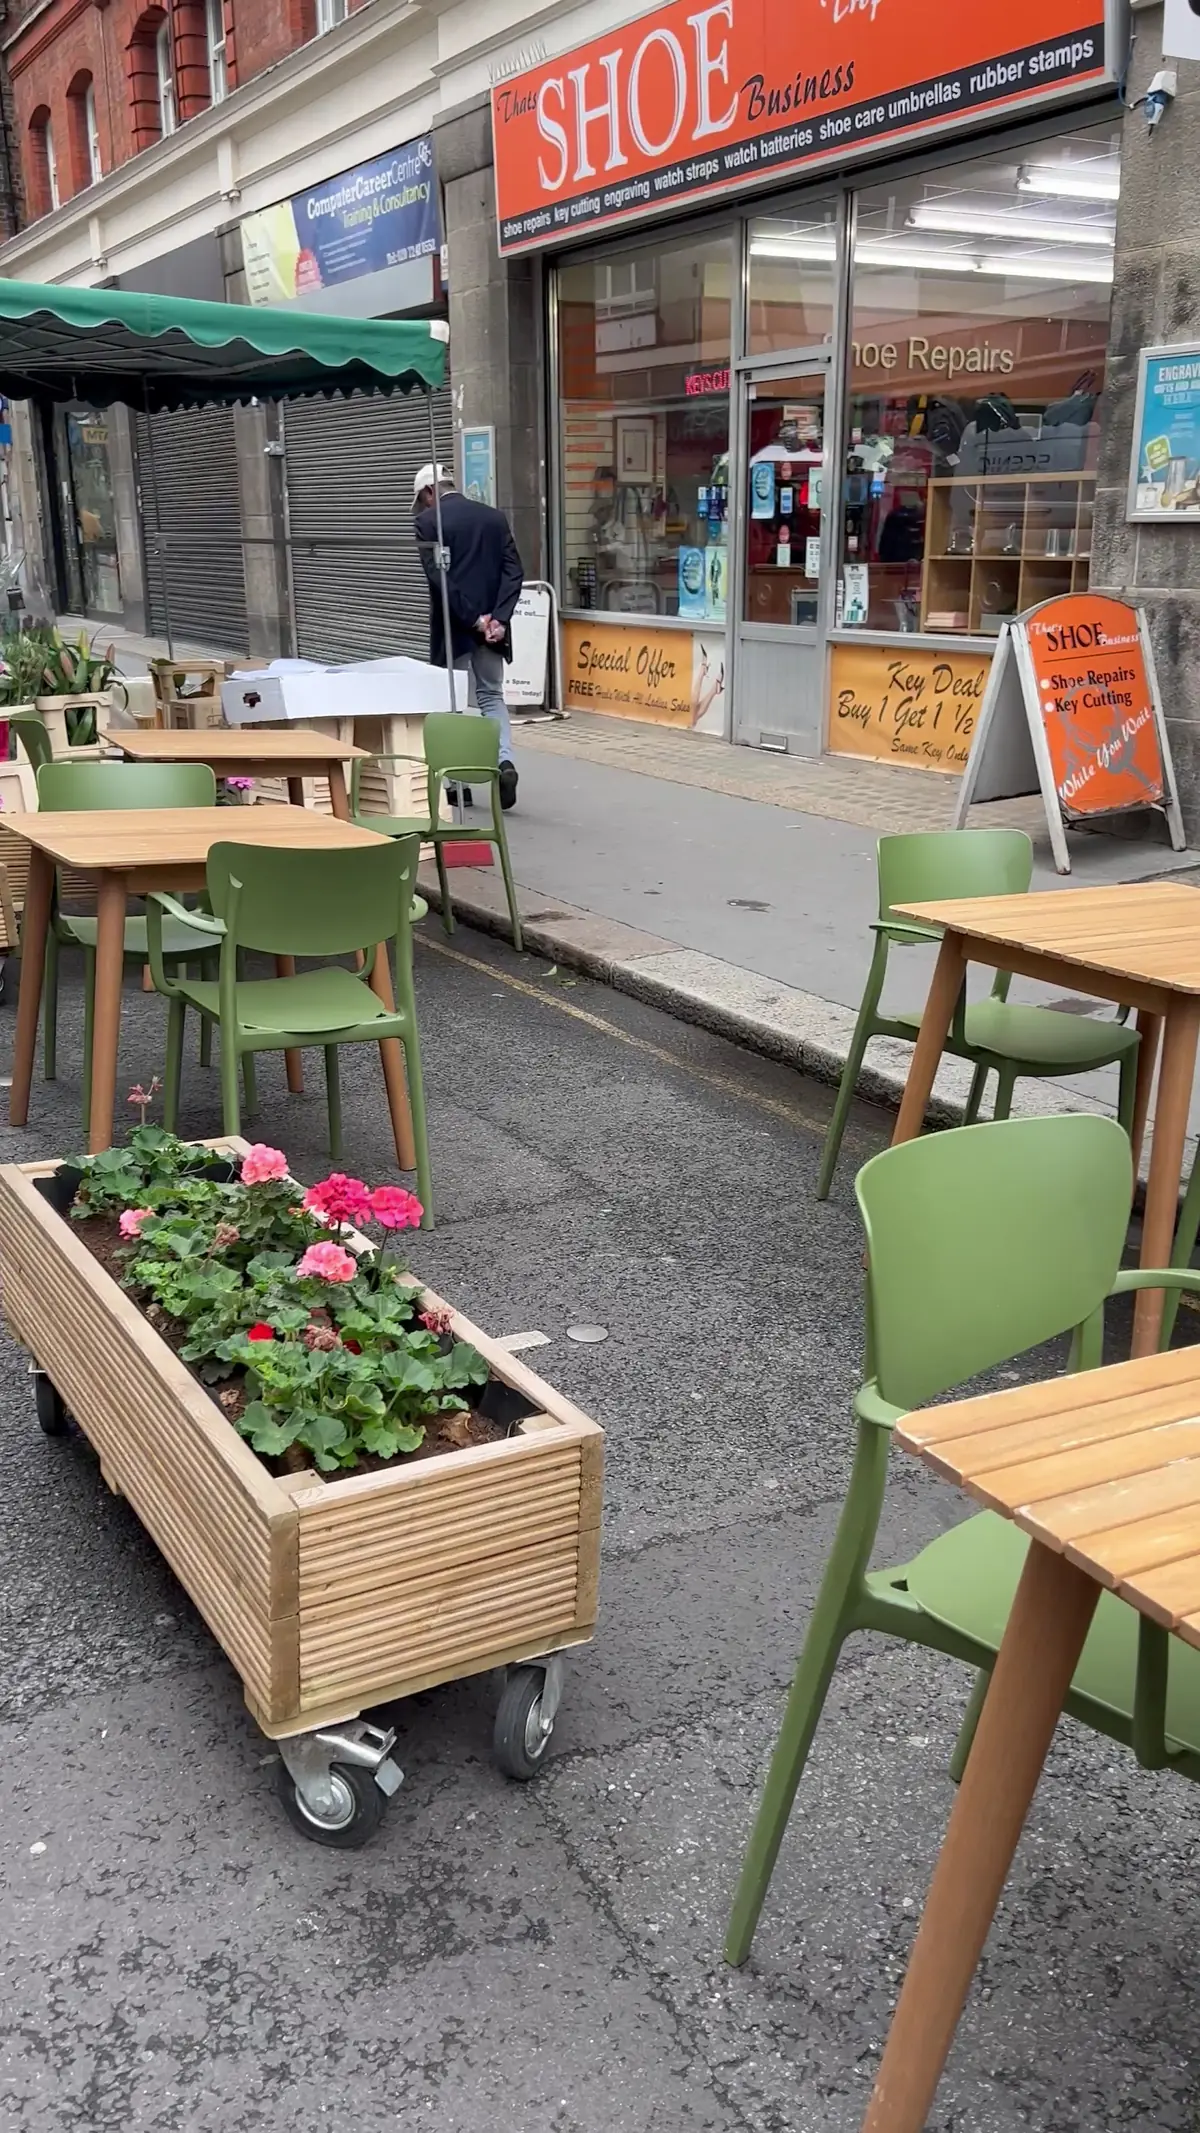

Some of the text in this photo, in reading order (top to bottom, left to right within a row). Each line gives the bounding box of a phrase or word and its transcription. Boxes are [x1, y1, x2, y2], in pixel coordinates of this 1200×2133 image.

[496, 90, 537, 123] Thats
[536, 0, 740, 191] SHOE
[739, 61, 856, 121] Business
[503, 39, 1094, 238] shoe repairs key cutting engraving watch straps watch batteries shoe care umbrellas rubber stamps
[908, 335, 1014, 379] Repairs
[1046, 621, 1104, 652] SHOE
[1096, 634, 1140, 647] Business
[576, 640, 676, 690] Special Offer
[887, 661, 985, 701] Key Deal
[1051, 666, 1136, 691] Shoe Repairs
[568, 679, 594, 697] FREE
[1053, 690, 1133, 715] Key Cutting
[838, 689, 872, 729] Buy
[878, 695, 889, 723] 1
[893, 696, 928, 736] Get
[933, 701, 944, 729] 1
[922, 741, 943, 760] Key
[1058, 706, 1151, 799] While You Wait
